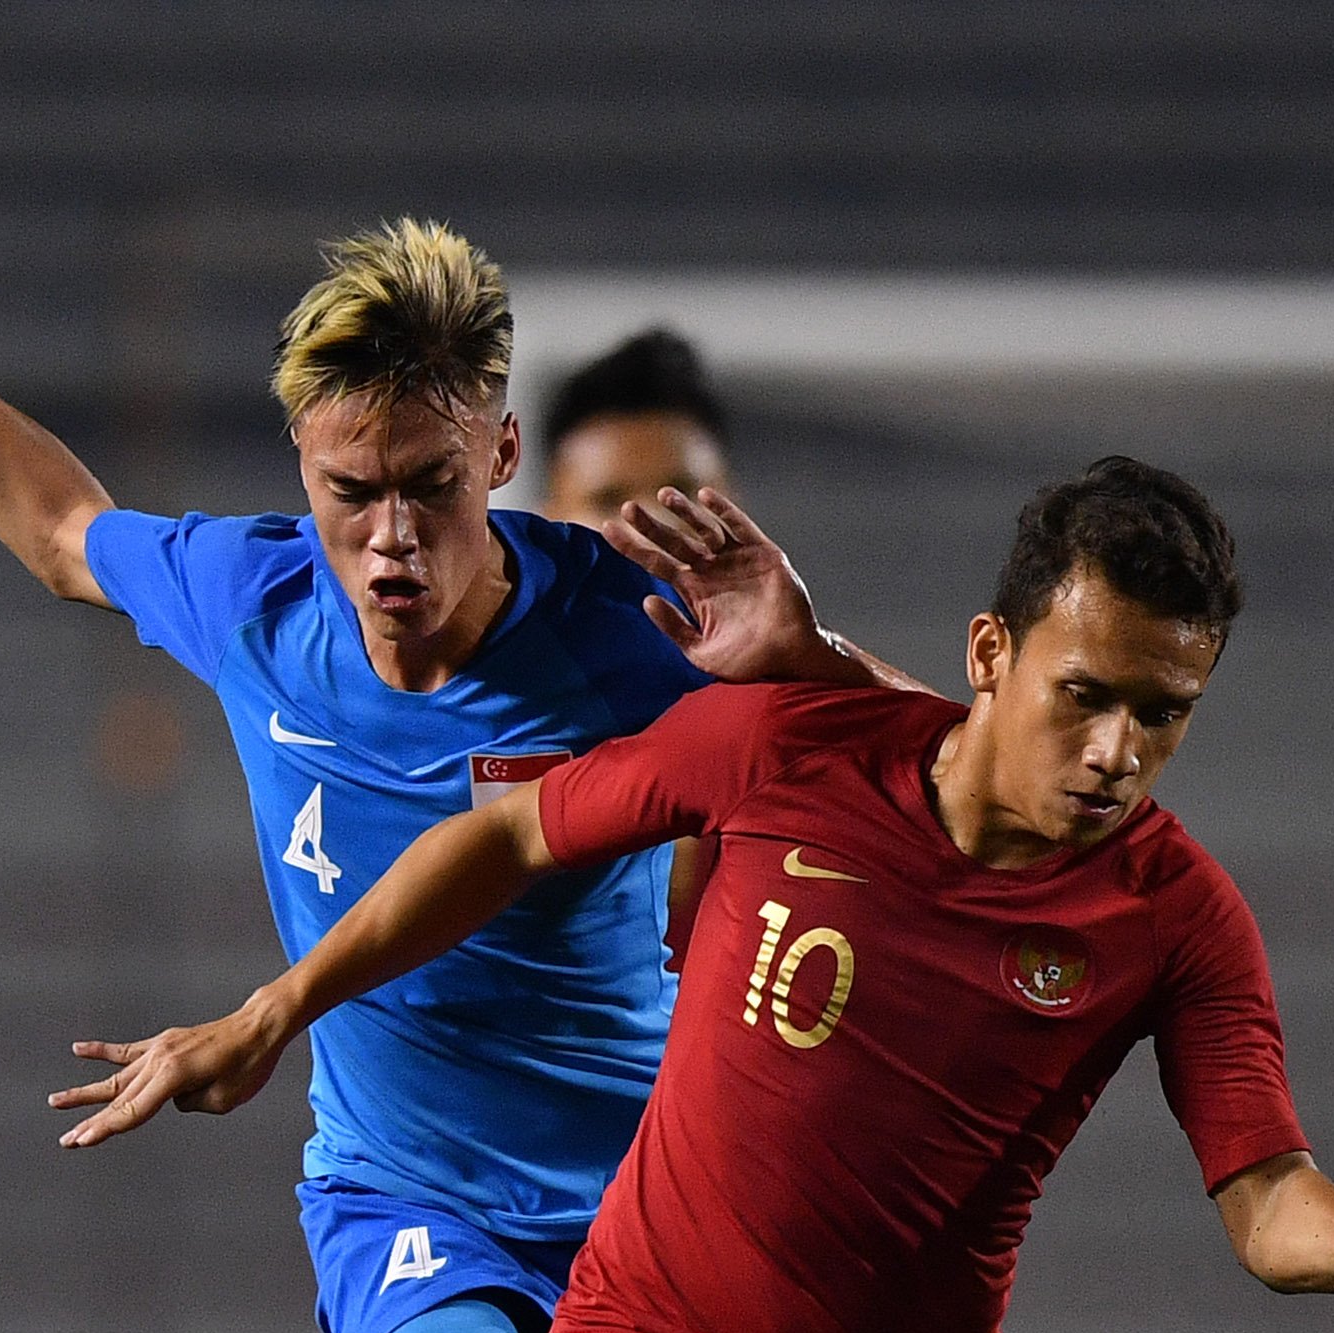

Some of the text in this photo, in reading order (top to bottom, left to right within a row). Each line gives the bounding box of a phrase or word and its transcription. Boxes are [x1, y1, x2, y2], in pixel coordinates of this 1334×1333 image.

[282, 782, 343, 894] 4
[742, 899, 854, 1049] 10
[378, 1226, 447, 1297] 4
